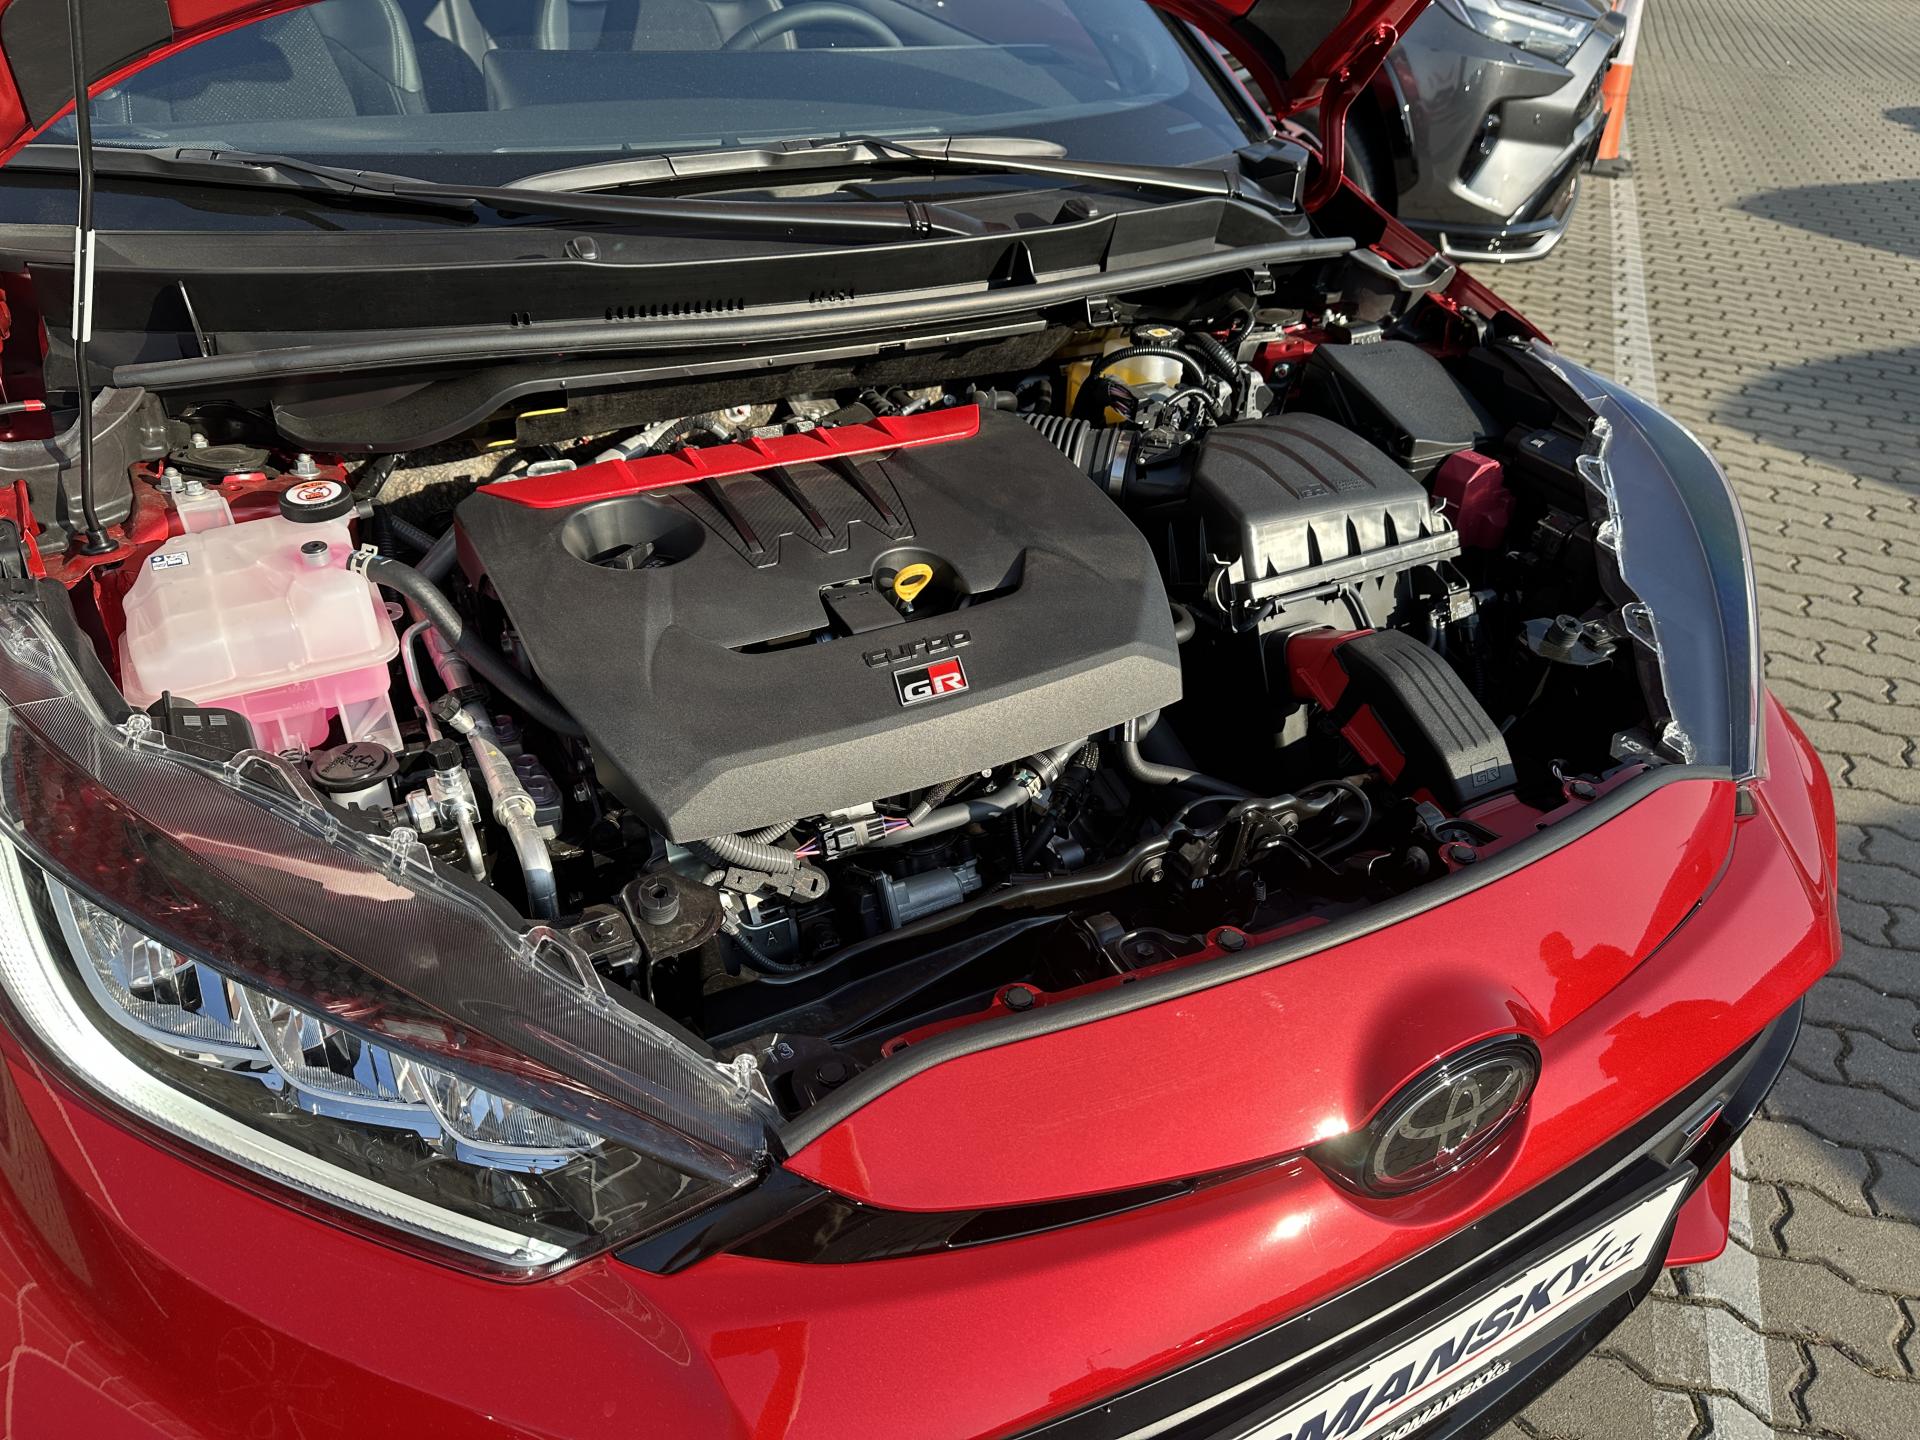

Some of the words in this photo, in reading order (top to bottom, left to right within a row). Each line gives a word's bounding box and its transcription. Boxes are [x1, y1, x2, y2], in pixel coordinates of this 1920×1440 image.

[862, 630, 971, 668] turbo
[903, 672, 965, 701] GR
[762, 1042, 794, 1063] T3
